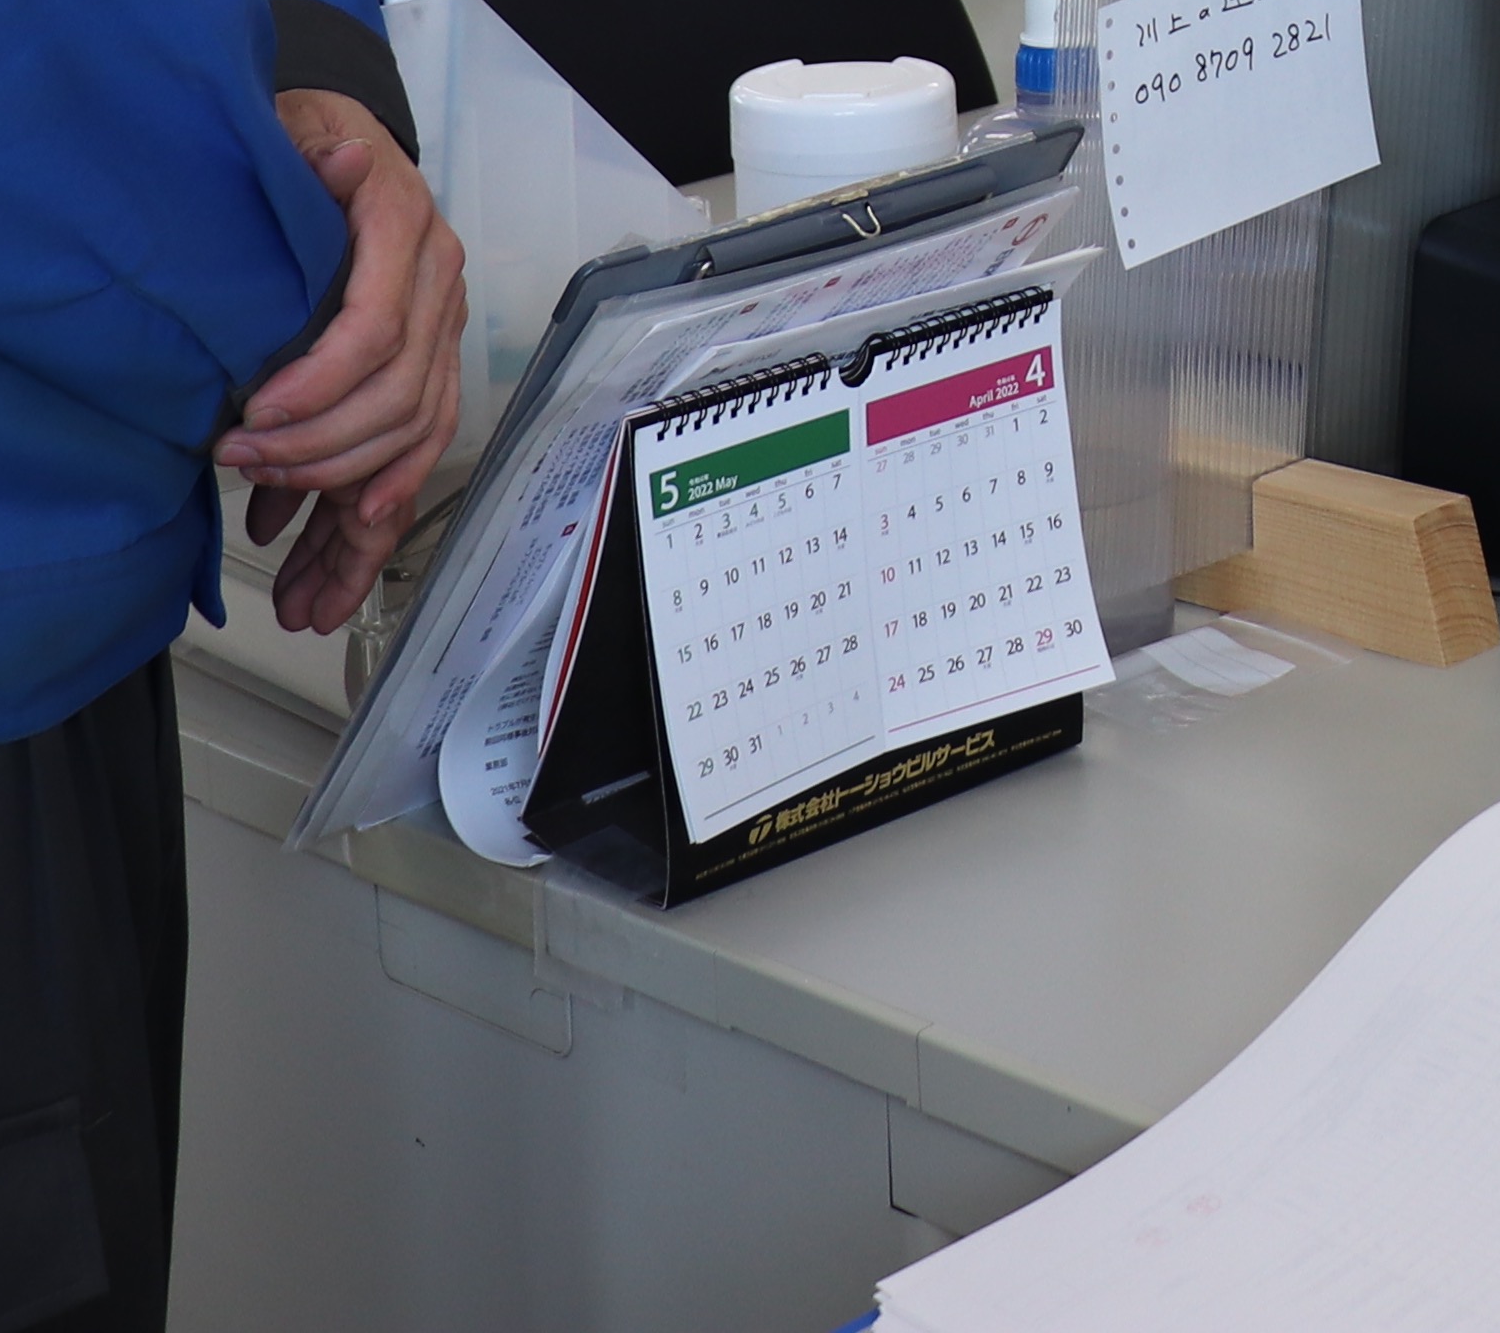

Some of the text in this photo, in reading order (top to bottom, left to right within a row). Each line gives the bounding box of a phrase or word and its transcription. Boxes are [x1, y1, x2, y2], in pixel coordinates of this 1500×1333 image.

[1134, 13, 1332, 105] 090 8709 2821
[969, 383, 1020, 409] April 2022
[1025, 354, 1046, 388] 4
[1013, 408, 1049, 432] 1 2
[660, 470, 679, 510] 5
[666, 473, 842, 549] 1 2 3 4 5 6 7
[688, 474, 739, 502] 2022 May
[881, 461, 1054, 530] 3 4 5 6 7 8 9
[672, 527, 848, 607] 8 9 10 11 12 13 14
[677, 581, 851, 664] 15 16 17 18 19 20 21
[888, 619, 1083, 693] 24 25 26 27 28 29 30
[686, 634, 859, 722] 22 23 24 25 26 27 28
[698, 734, 763, 779] 29 30 31
[775, 729, 997, 834] 株式会社トーショウビルサービス
